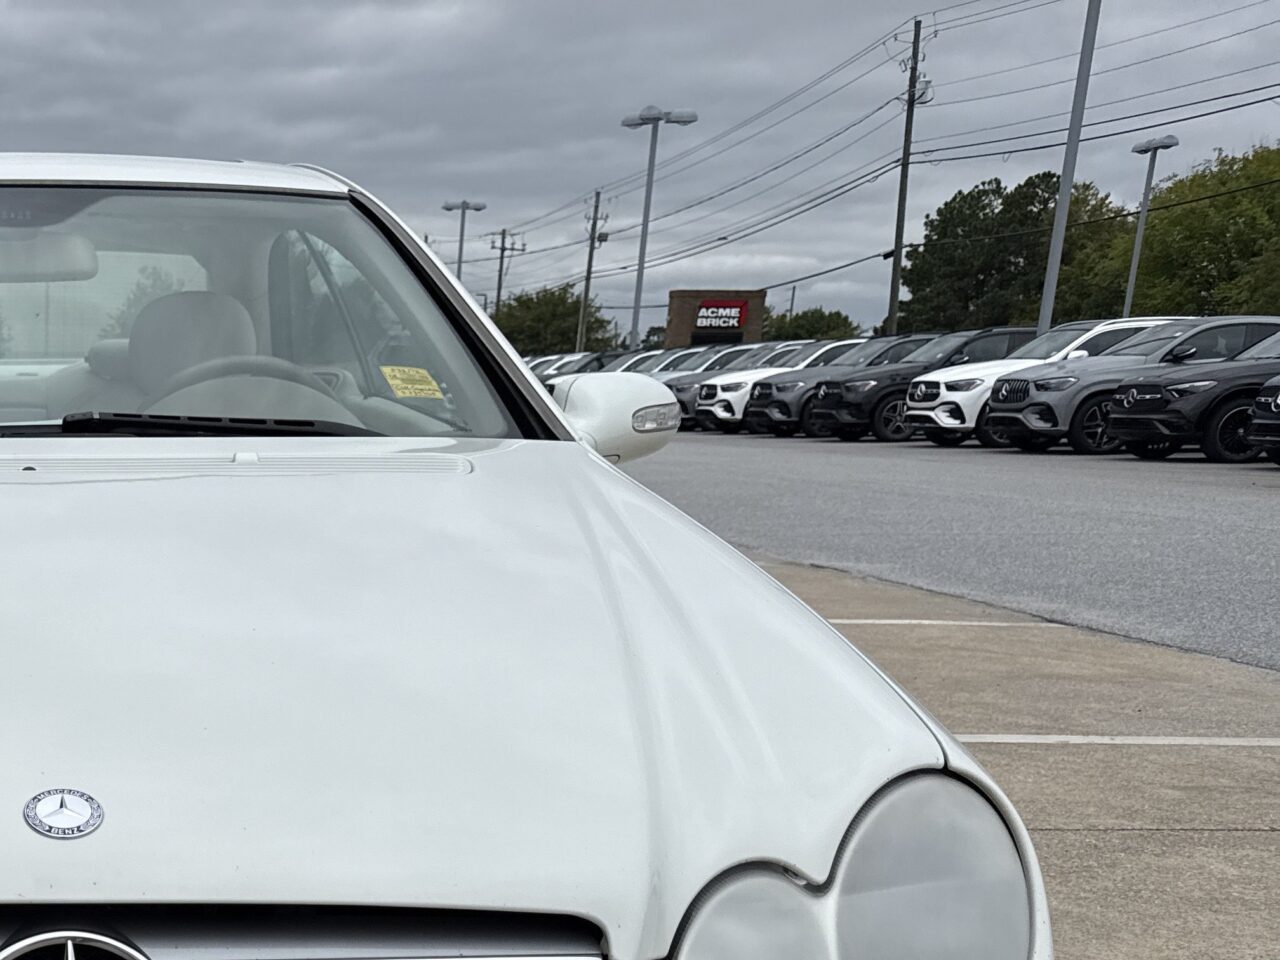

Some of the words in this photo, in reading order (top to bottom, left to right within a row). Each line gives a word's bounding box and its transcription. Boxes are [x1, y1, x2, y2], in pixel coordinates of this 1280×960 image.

[698, 308, 740, 317] ACME
[696, 318, 739, 327] BRICK
[37, 789, 89, 800] MERCEDES
